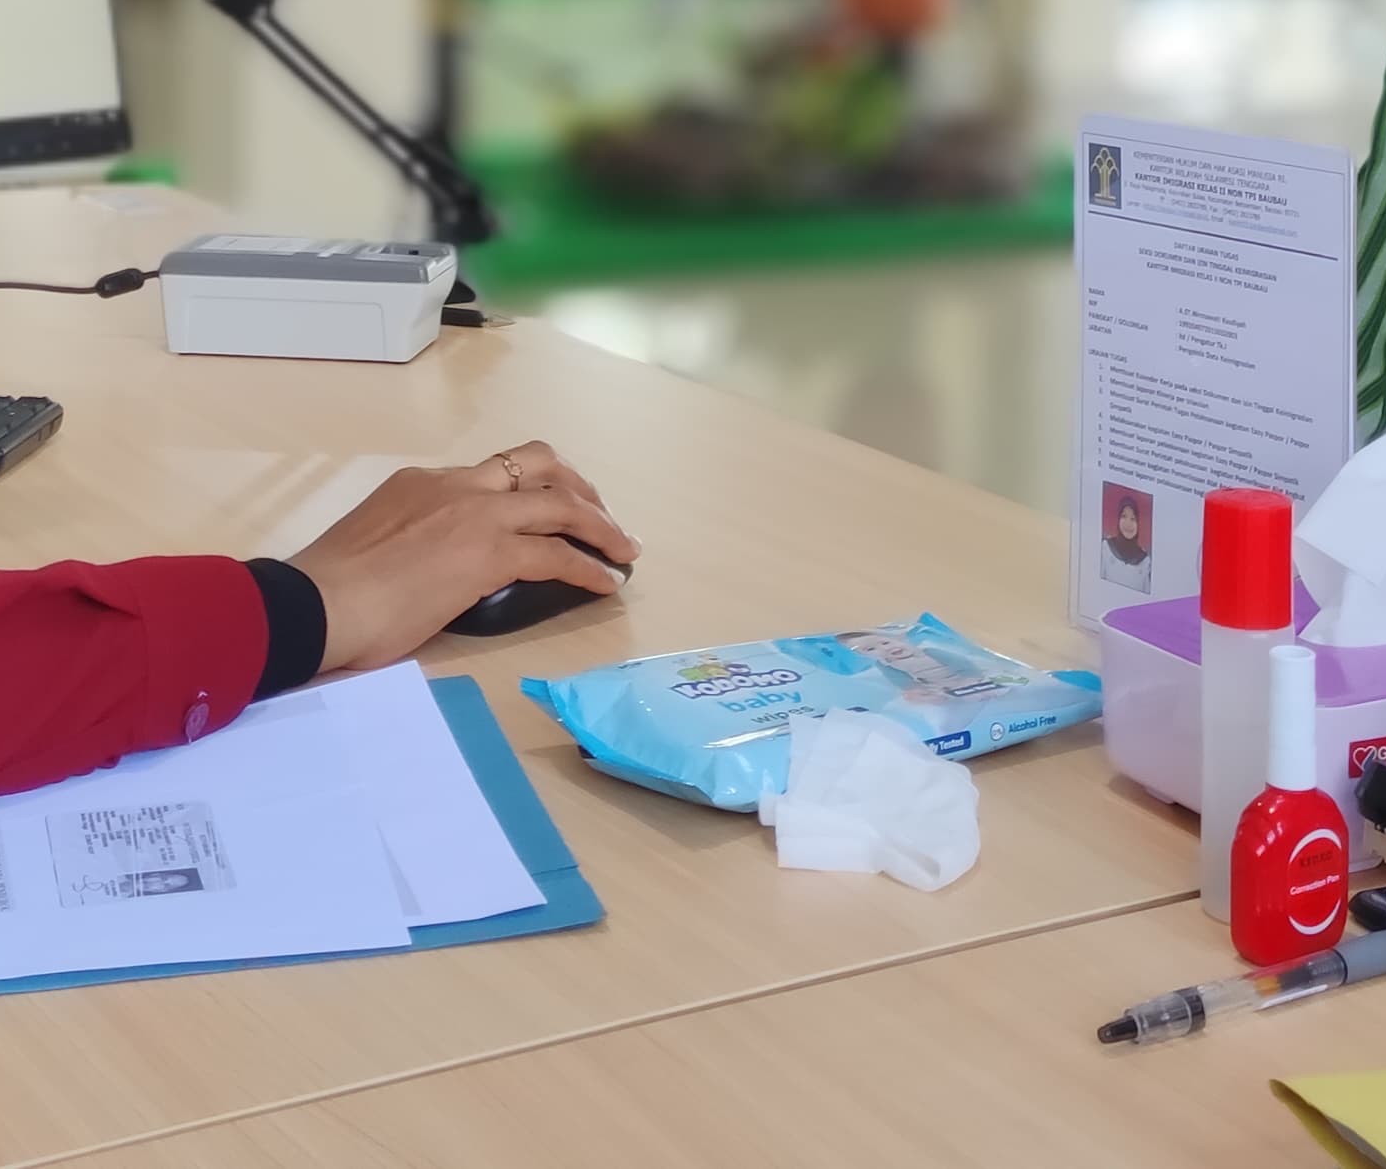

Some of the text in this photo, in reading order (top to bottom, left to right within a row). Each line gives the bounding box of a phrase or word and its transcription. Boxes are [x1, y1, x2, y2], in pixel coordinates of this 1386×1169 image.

[1135, 172, 1160, 185] KANTOR
[1197, 183, 1217, 194] KELAS
[1227, 188, 1243, 198] NON
[1258, 193, 1287, 205] BAUBAU
[669, 668, 803, 699] KODOMO
[718, 691, 803, 713] baby
[751, 705, 815, 725] wipes
[1008, 715, 1057, 733] Alcohol Free
[939, 735, 964, 750] Tested
